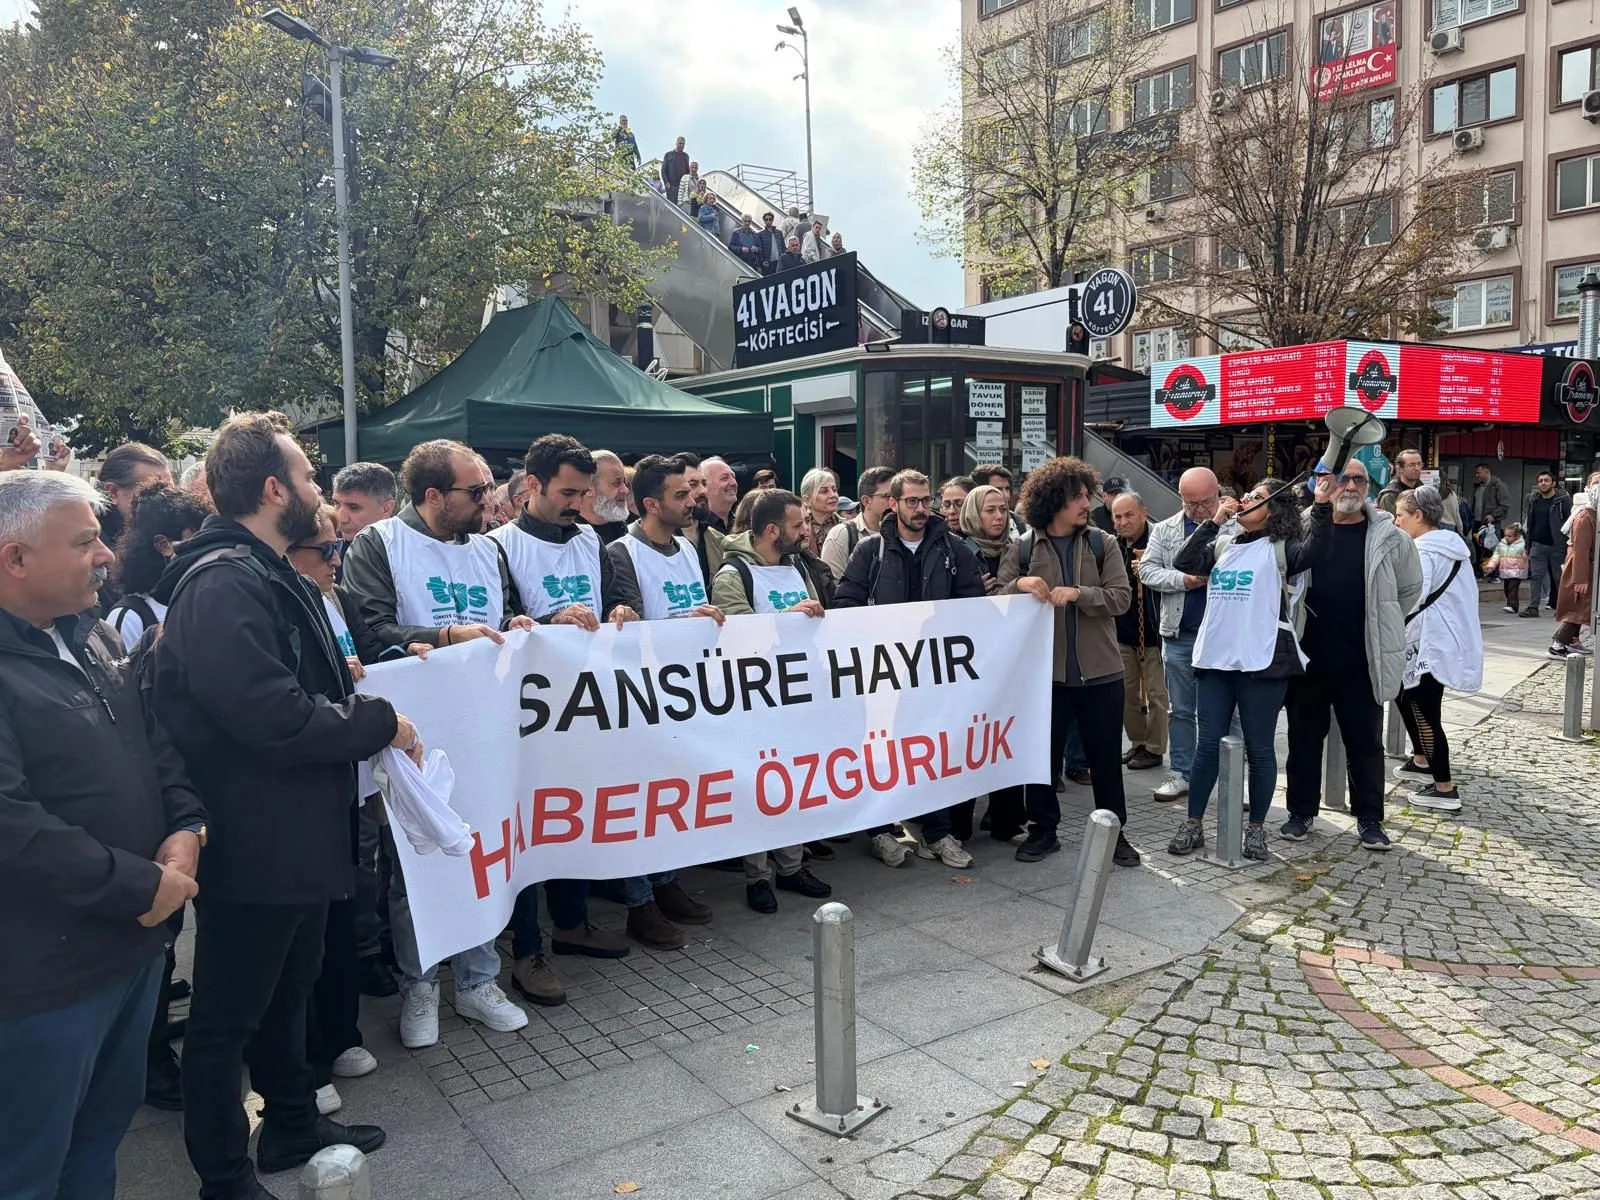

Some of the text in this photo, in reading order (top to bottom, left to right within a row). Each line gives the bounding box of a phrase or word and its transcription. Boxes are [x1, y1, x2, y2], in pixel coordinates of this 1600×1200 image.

[1089, 272, 1120, 291] VAGON
[737, 268, 836, 328] 41 VAGON
[1094, 290, 1115, 316] 41
[750, 313, 823, 351] KÖFTECİSİ
[951, 319, 968, 328] GAR
[543, 574, 592, 602] tgs
[1211, 568, 1253, 591] tgs
[426, 576, 488, 612] tgs
[663, 581, 706, 608] tgs
[520, 635, 980, 738] SANSÜRE HAYIR
[471, 714, 1014, 898] HABERE ÖZGÜRLÜK
